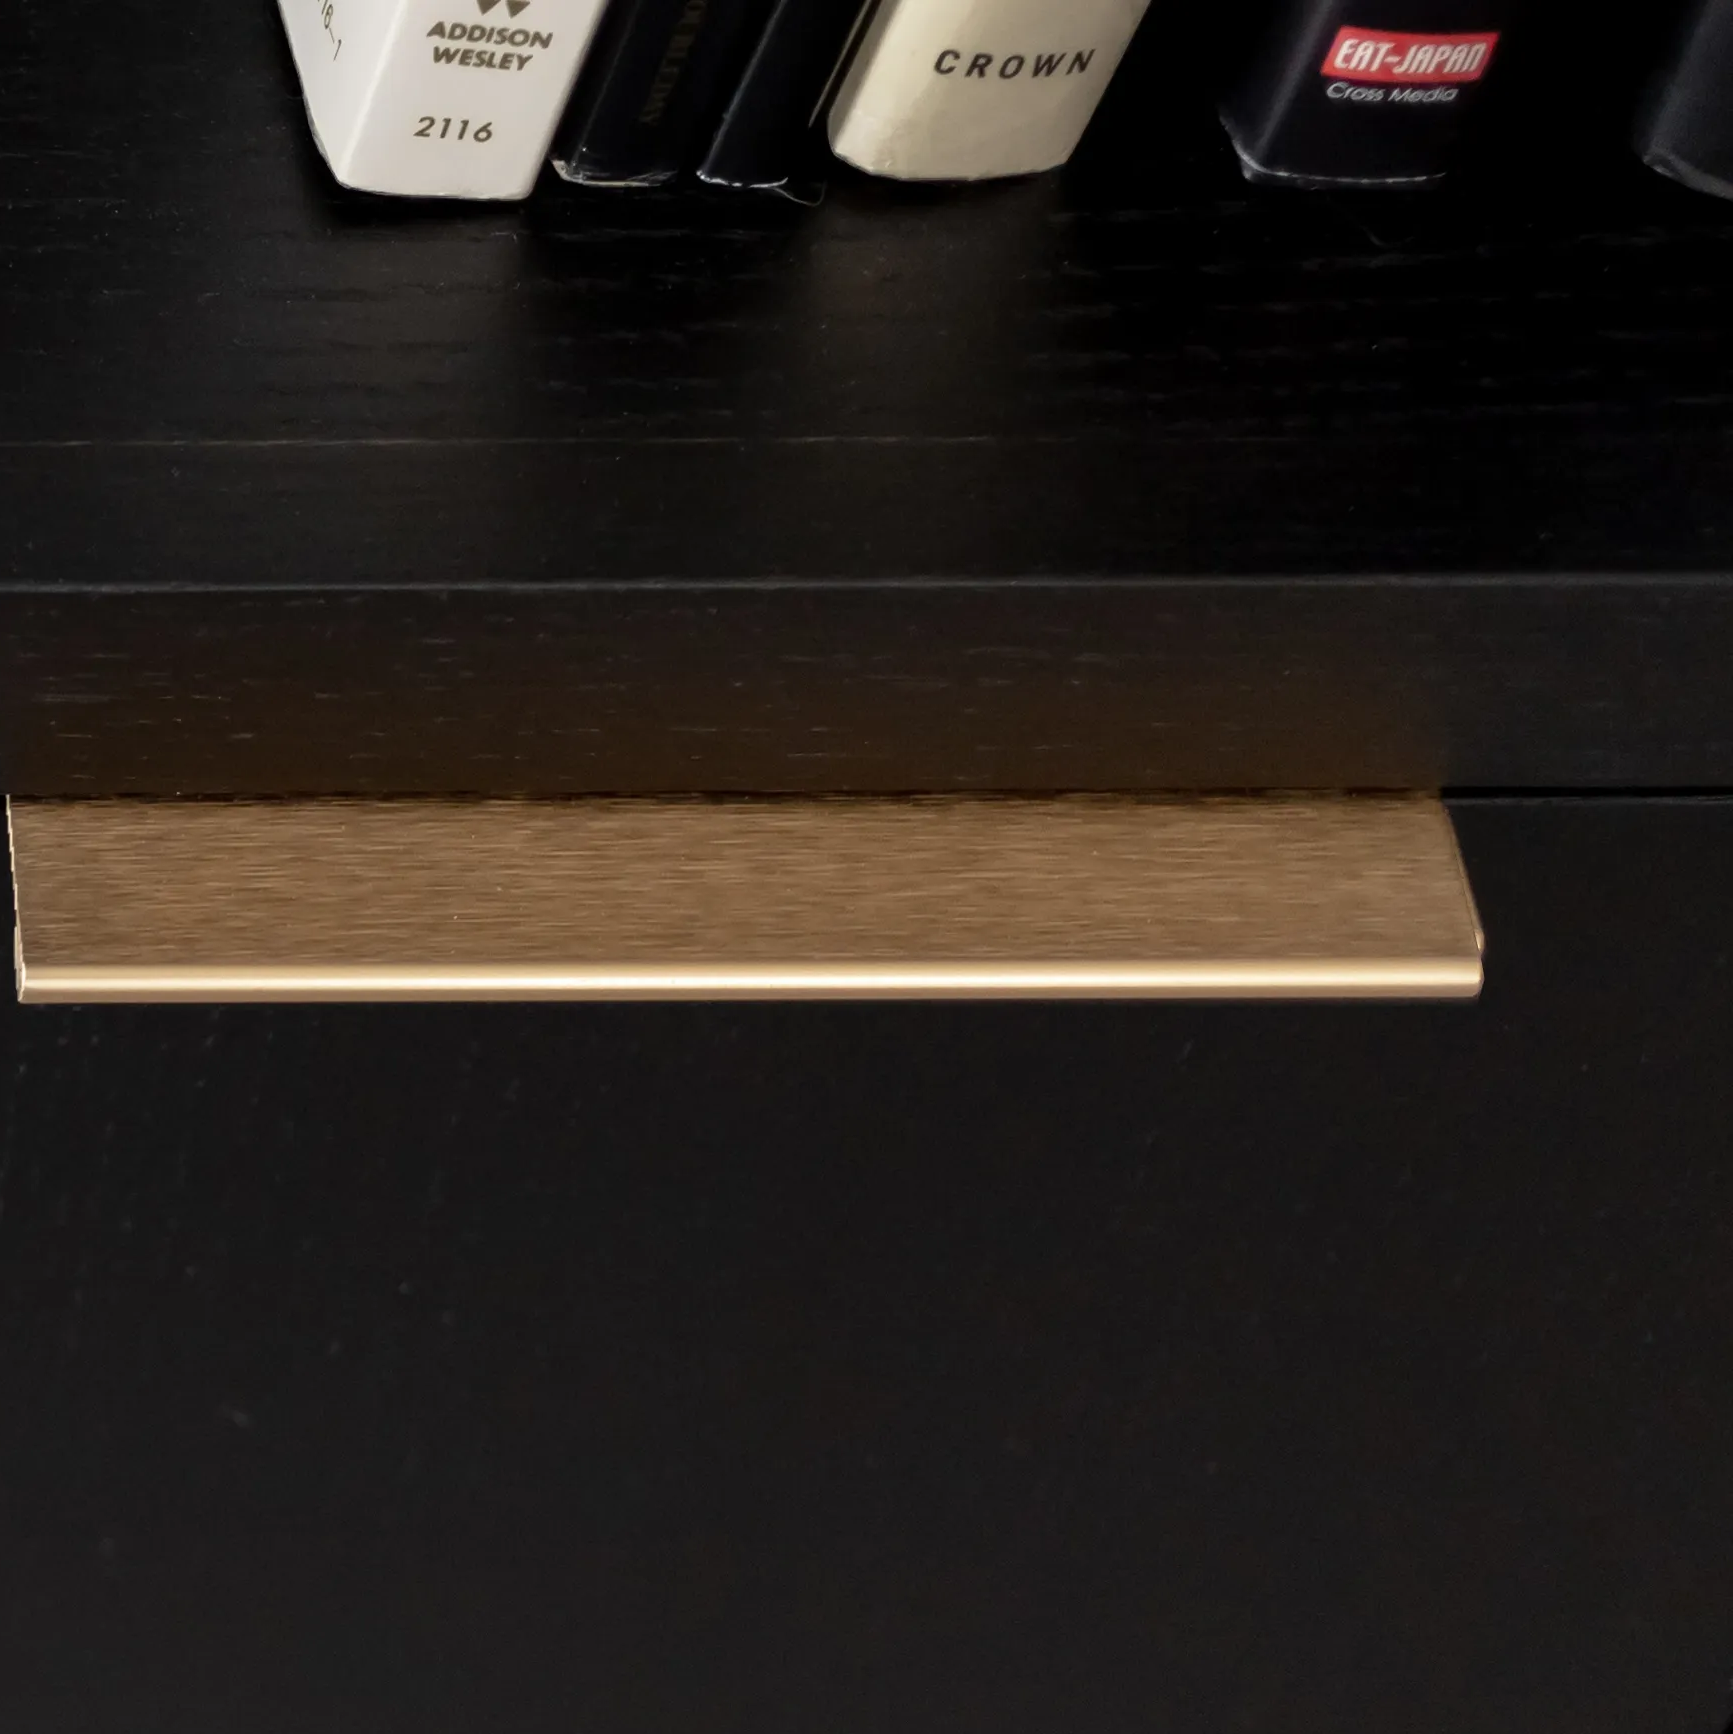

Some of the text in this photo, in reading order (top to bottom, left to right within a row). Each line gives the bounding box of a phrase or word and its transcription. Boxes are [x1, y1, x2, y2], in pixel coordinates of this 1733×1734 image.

[426, 21, 554, 49] ADDISON
[433, 46, 533, 71] WESLEY
[934, 49, 1096, 79] CROWN
[1334, 38, 1488, 74] EAT-JAPAN
[1326, 81, 1460, 102] Cross Media
[413, 116, 493, 143] 2116
